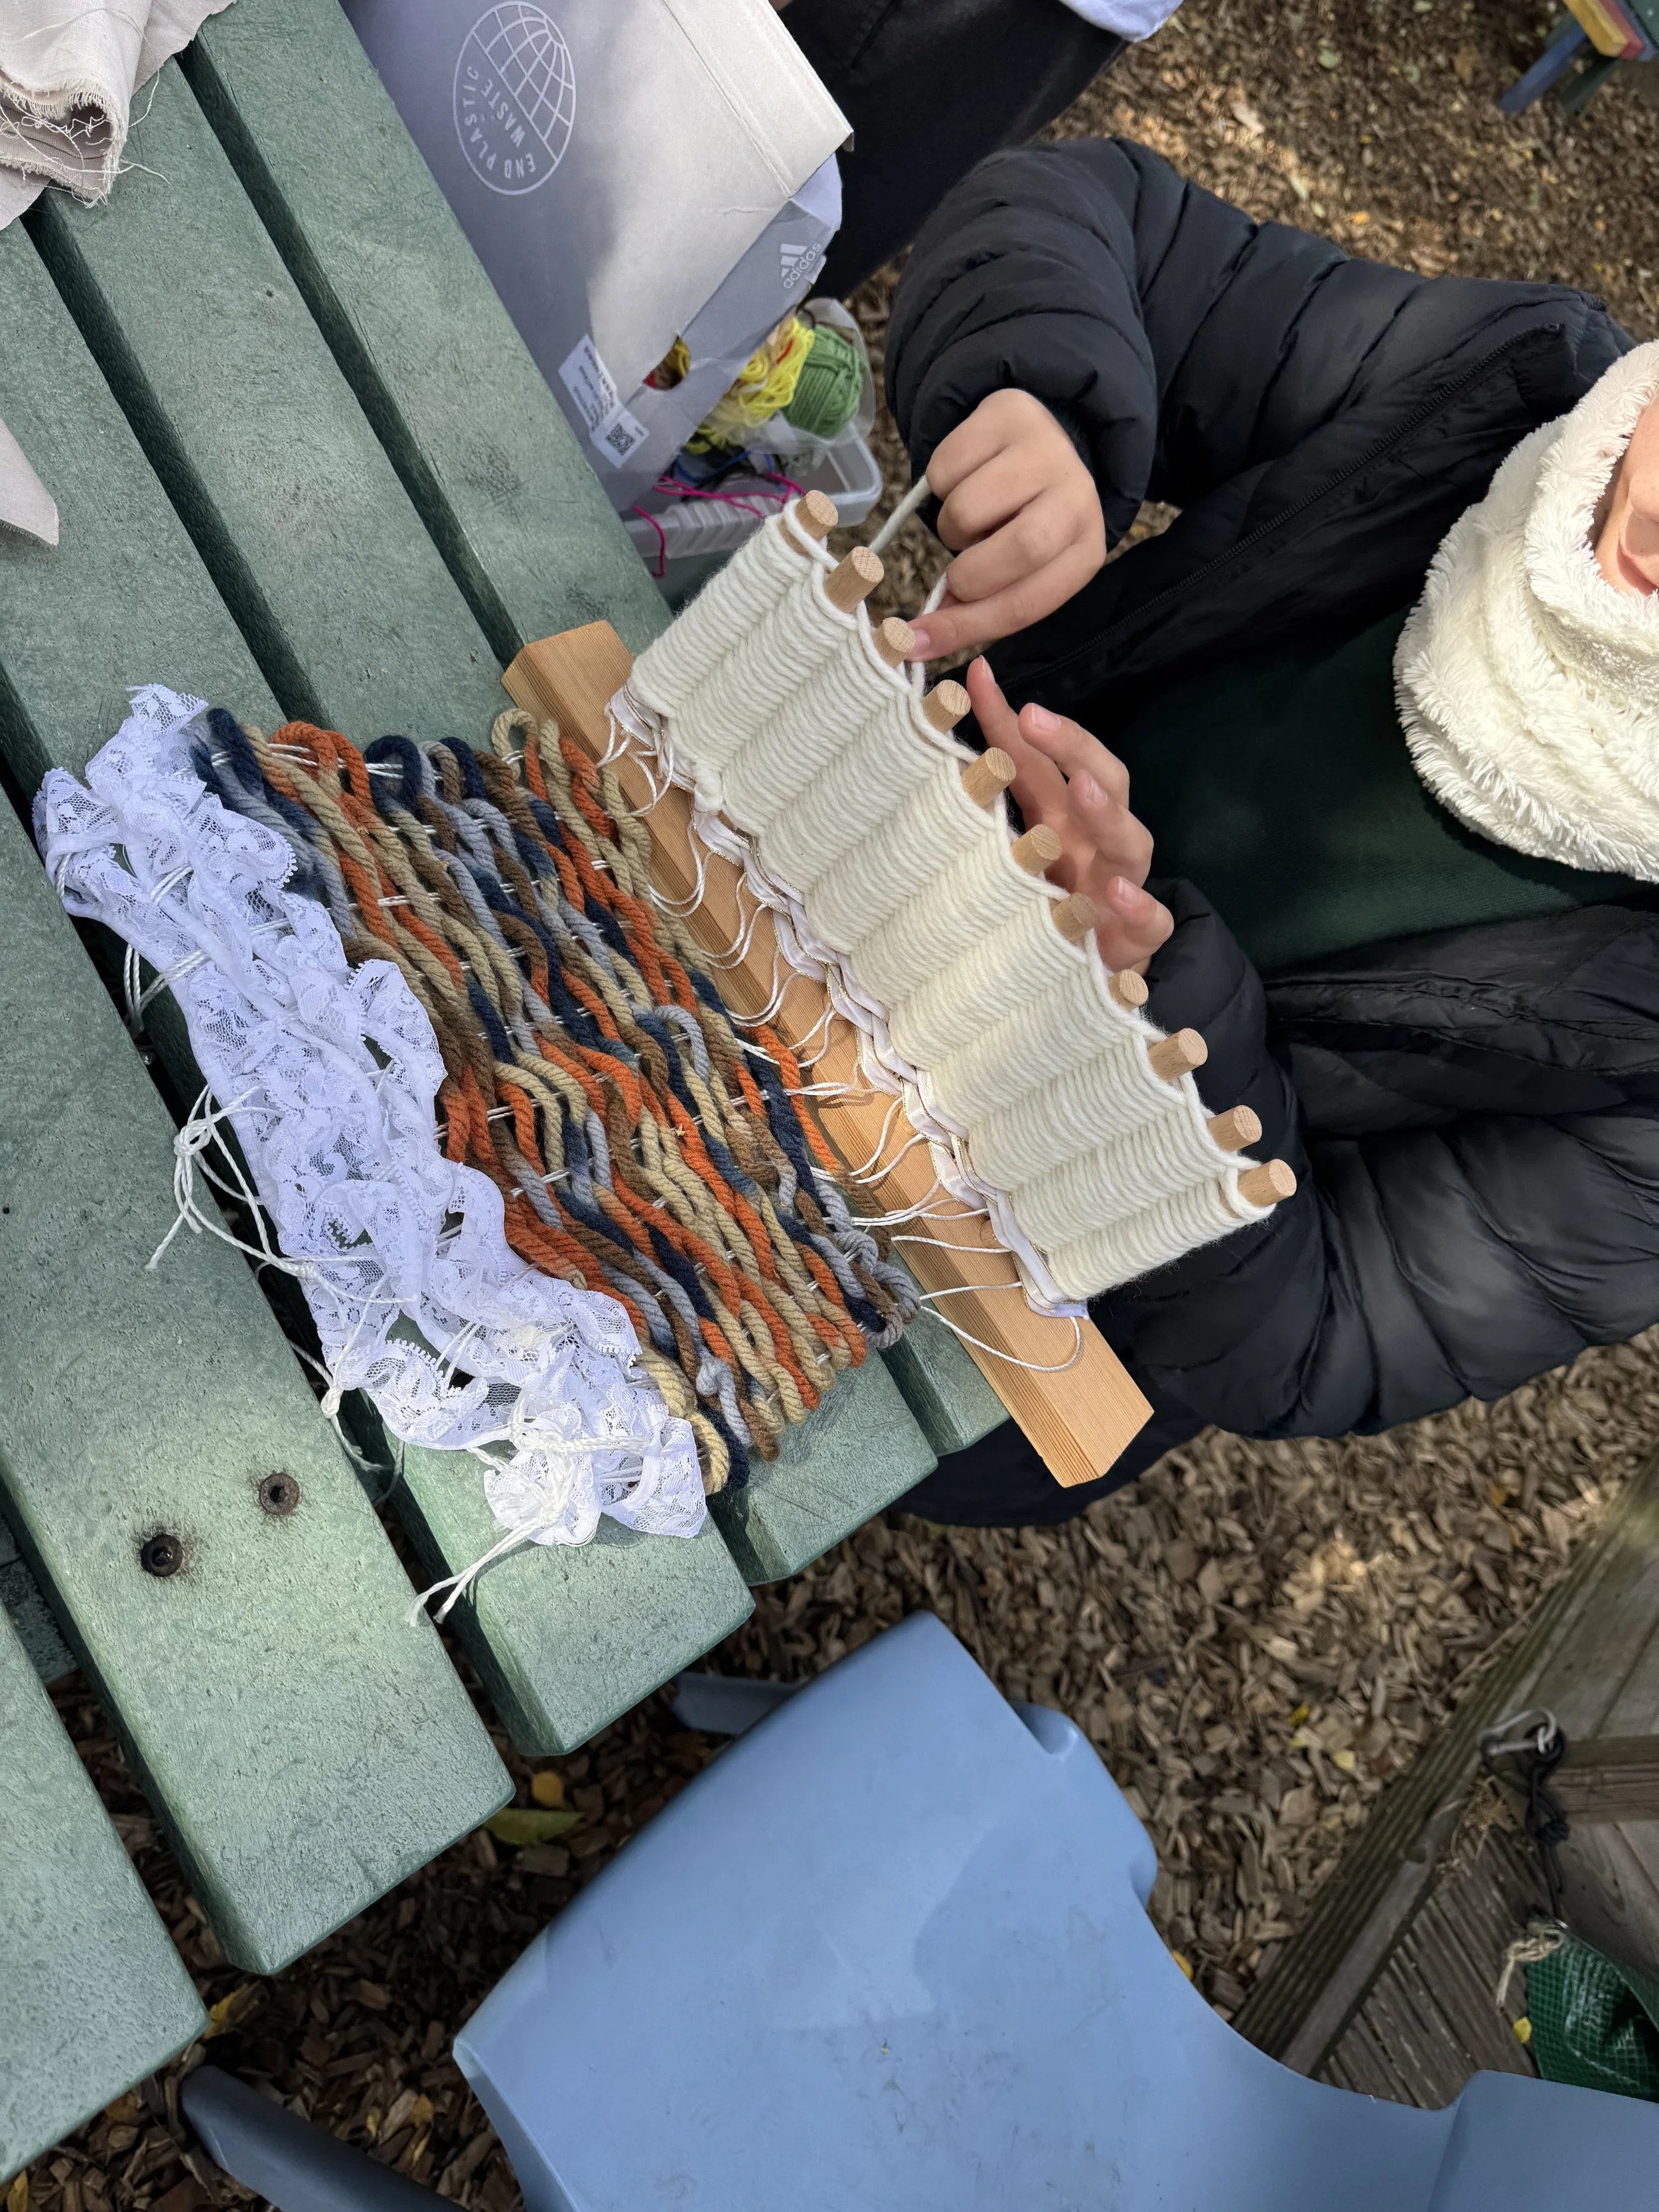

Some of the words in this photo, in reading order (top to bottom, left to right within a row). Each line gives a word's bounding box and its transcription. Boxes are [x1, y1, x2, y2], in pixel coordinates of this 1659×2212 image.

[463, 66, 497, 171] PLASTIC
[480, 78, 526, 148] WASTE
[503, 152, 536, 179] END
[783, 242, 822, 289] adidas
